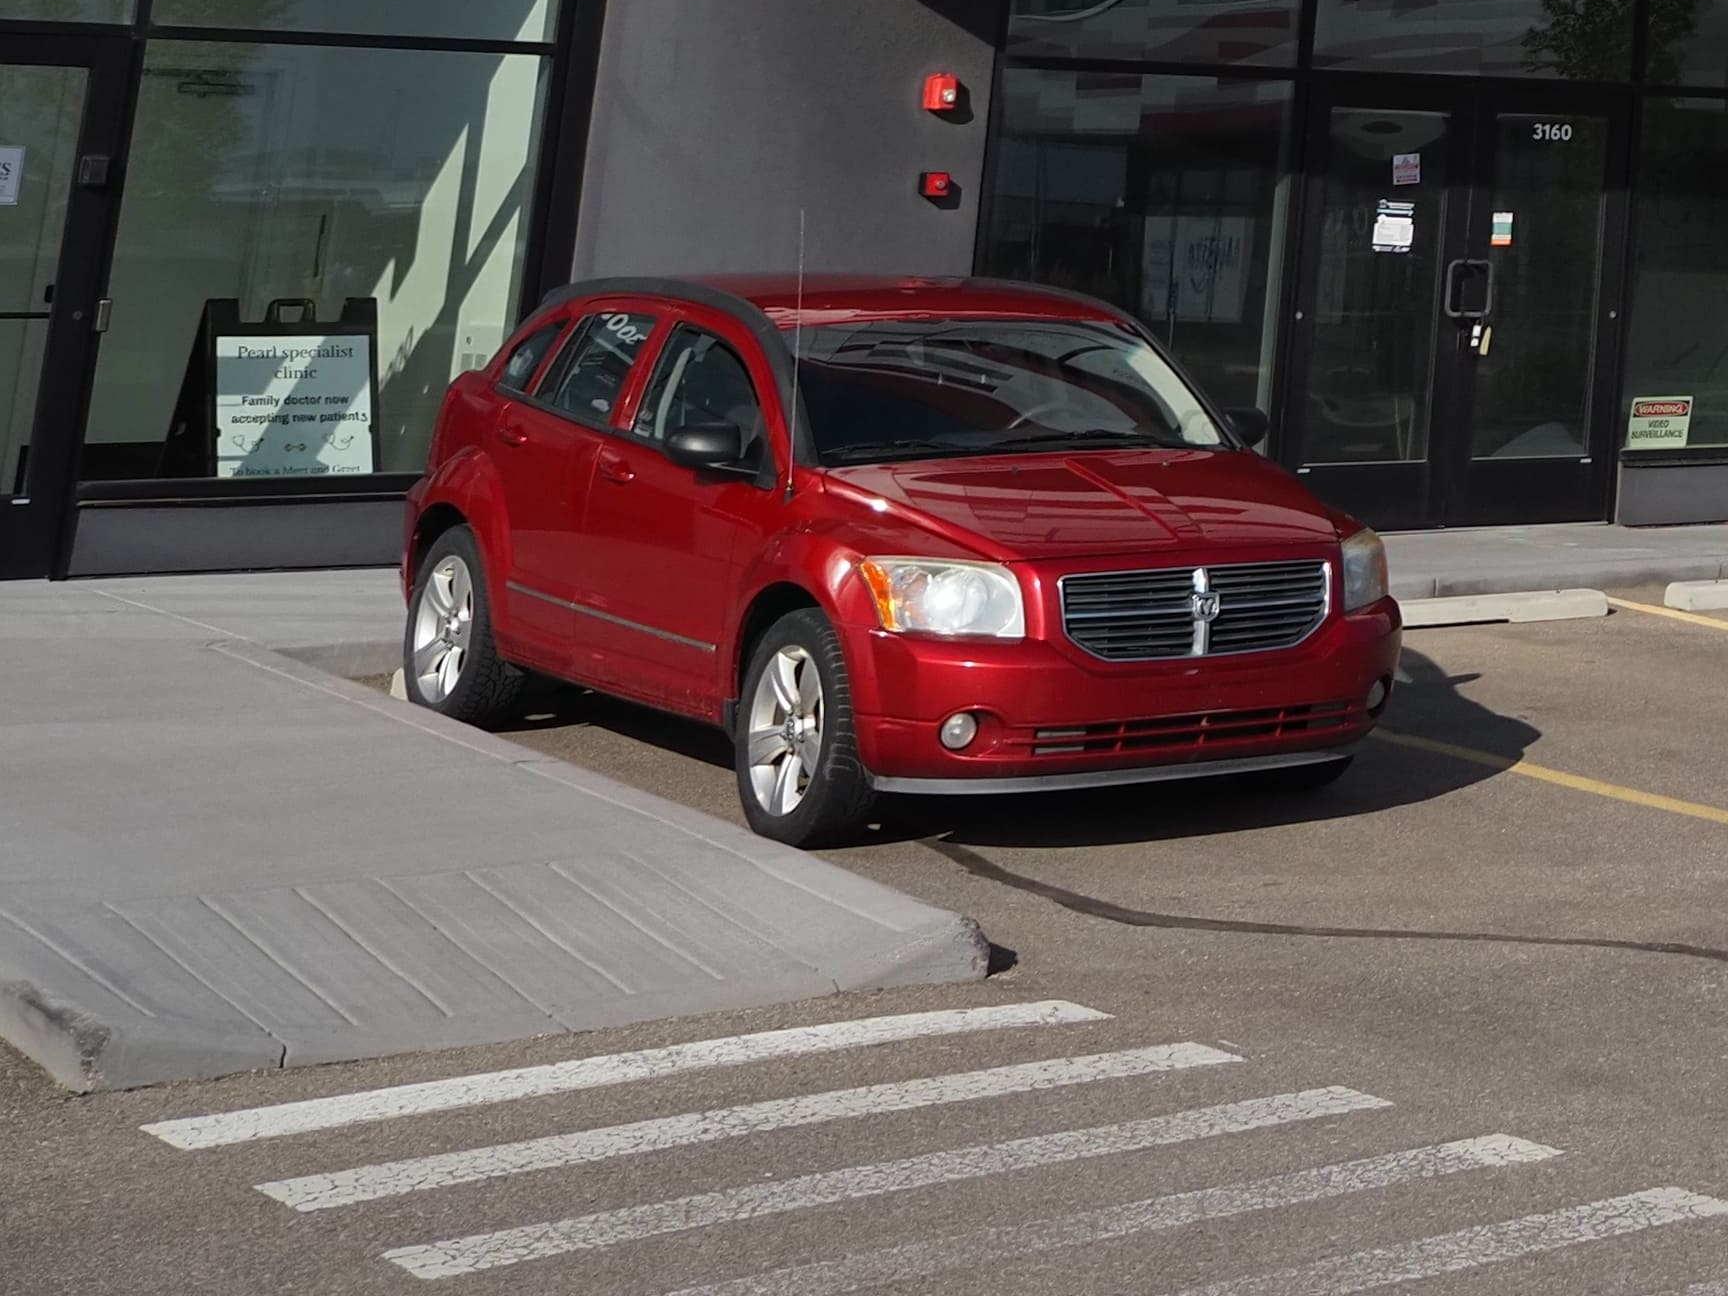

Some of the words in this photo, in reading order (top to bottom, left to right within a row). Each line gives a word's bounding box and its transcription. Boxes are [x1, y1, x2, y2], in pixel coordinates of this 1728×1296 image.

[1532, 122, 1573, 142] 3160
[238, 346, 277, 359] Pearl
[282, 344, 353, 362] specialist
[274, 365, 318, 379] clinic
[241, 396, 280, 407] Family
[284, 395, 321, 406] doctor
[325, 396, 349, 405] now
[1638, 404, 1684, 414] WARNING
[231, 414, 290, 425] accepting
[292, 415, 316, 423] new
[319, 411, 368, 424] patients
[1648, 419, 1670, 428] VIDEO
[1631, 429, 1683, 439] SURVEILLANCE
